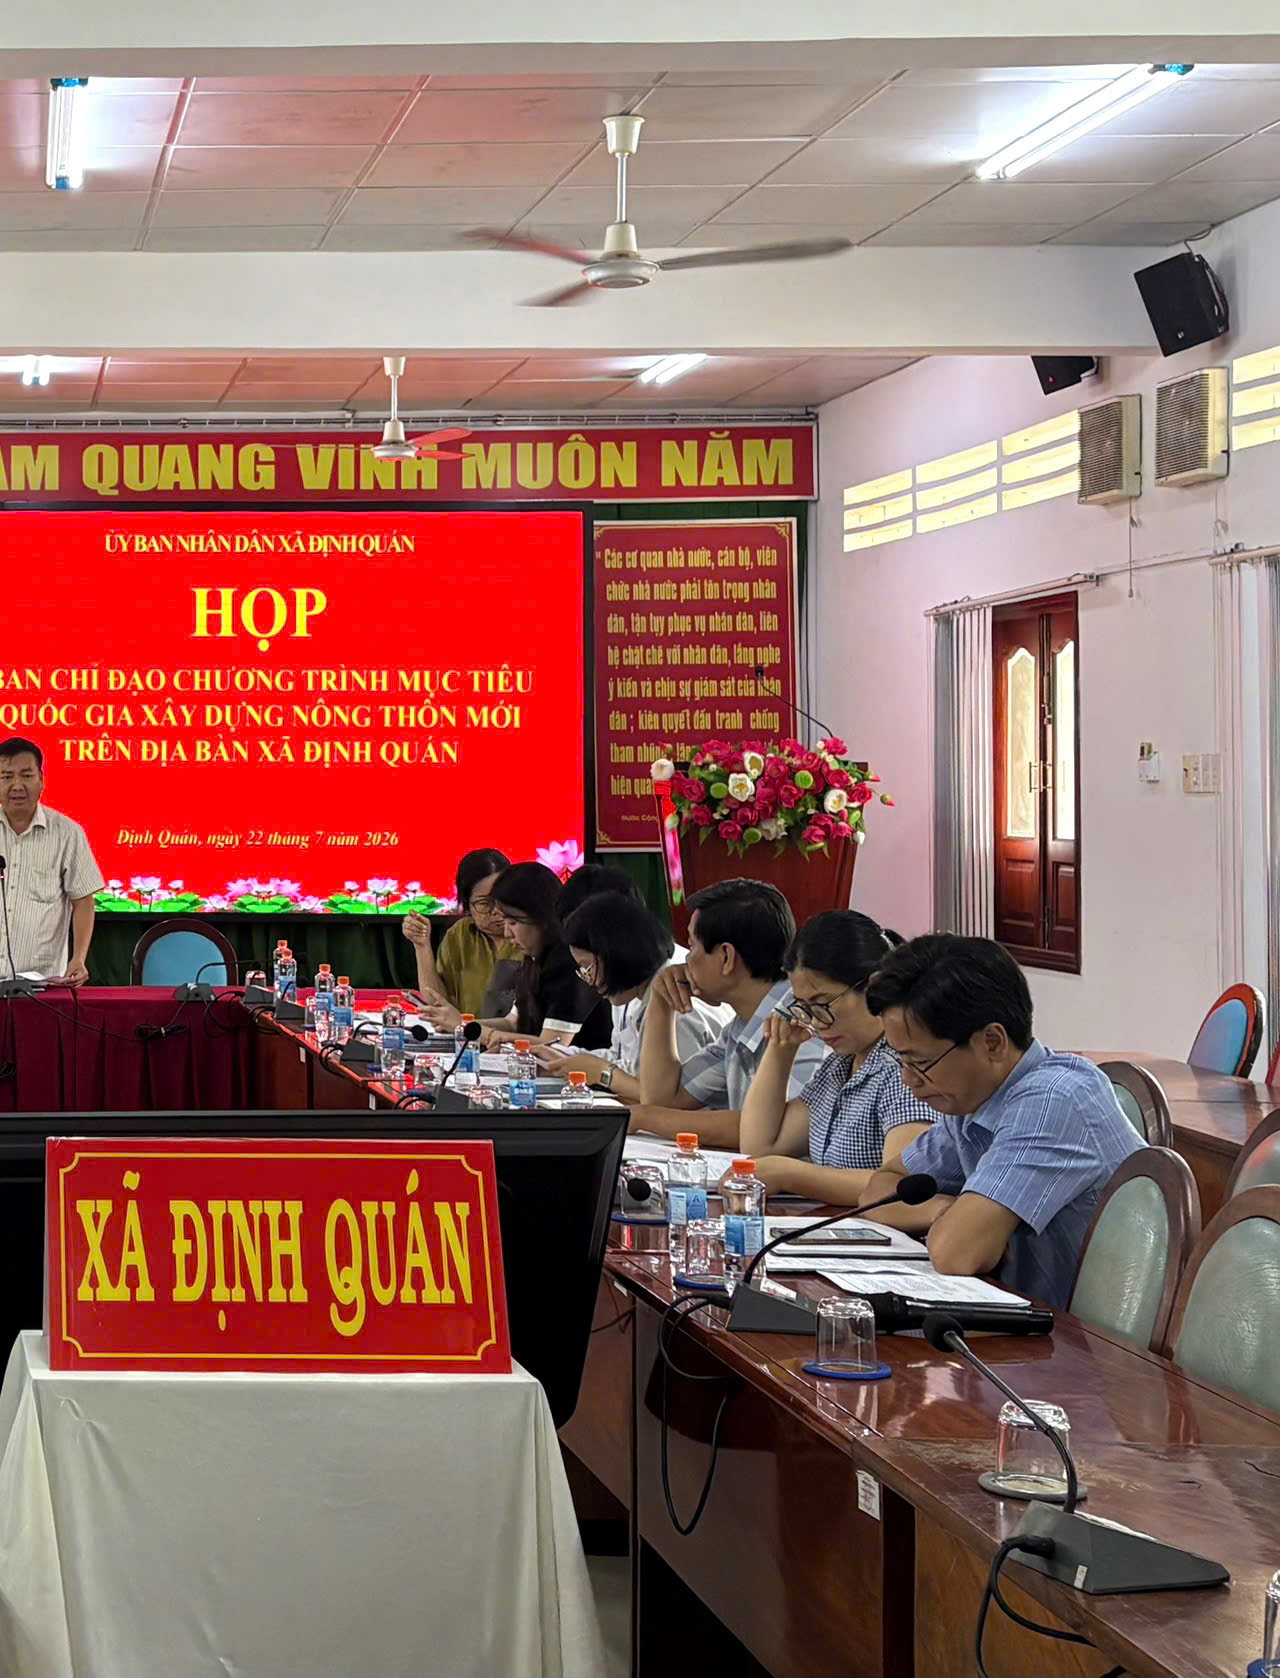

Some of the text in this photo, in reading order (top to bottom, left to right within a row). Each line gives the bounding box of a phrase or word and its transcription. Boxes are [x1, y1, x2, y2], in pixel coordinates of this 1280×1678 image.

[82, 444, 275, 496] QUANG
[296, 444, 438, 490] VINH
[462, 433, 637, 490] MUÔN
[661, 431, 794, 487] NĂM
[105, 529, 415, 557] ỦY BAN NHÂN DÂN XÃ ĐỊNH QUÁN
[191, 588, 327, 652] HỌP
[109, 669, 166, 696] ĐẠO
[173, 666, 294, 691] CHƯƠNG
[302, 664, 389, 692] TRÌNH
[398, 670, 461, 698] MỤC
[467, 664, 533, 692] TIÊU
[85, 704, 134, 726] GIA
[141, 697, 197, 726] XÂY
[205, 701, 284, 732] DỰNG
[292, 697, 371, 728] NÔNG
[379, 697, 456, 728] THÔN
[466, 700, 521, 728] MỚI
[60, 732, 459, 768] TRÊN ĐỊA BÀN XÃ ĐỊNH QUÁN
[117, 829, 400, 849] Định Quán, ngày 22 tháng 7 năm 2026
[76, 1169, 473, 1337] XÃ ĐỊNH QUÁN
